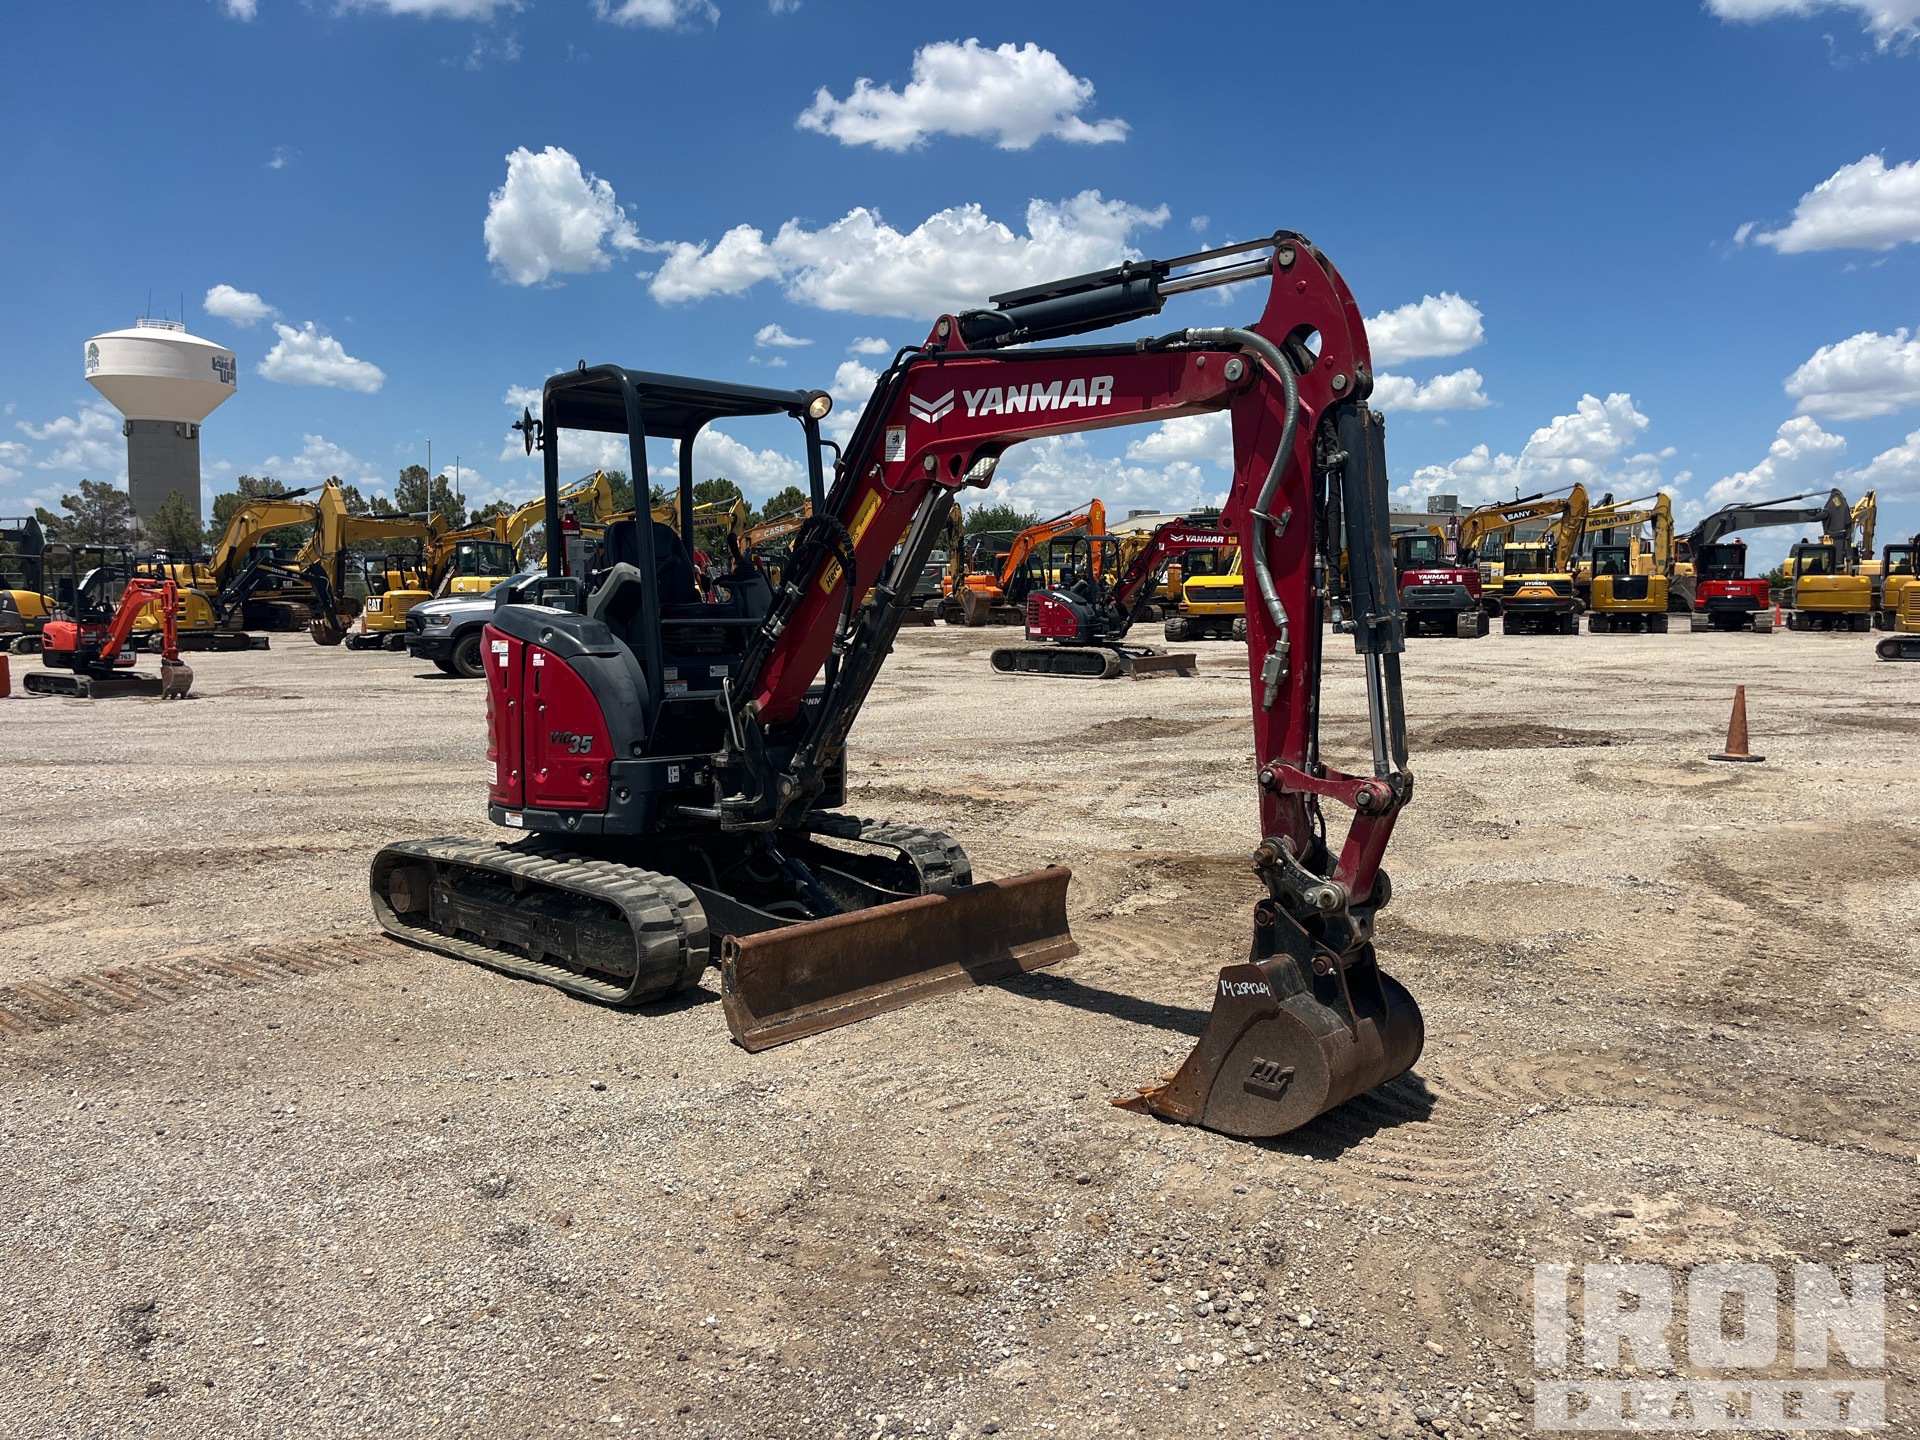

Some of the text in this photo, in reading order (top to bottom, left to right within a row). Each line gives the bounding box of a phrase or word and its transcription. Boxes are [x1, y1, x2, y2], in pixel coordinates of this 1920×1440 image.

[962, 375, 1114, 418] YANMAR
[1507, 510, 1531, 521] SANY
[1589, 514, 1630, 528] KOMATSU
[764, 525, 785, 537] CASE
[1185, 534, 1224, 543] YANMAR
[271, 567, 287, 576] DEERE
[367, 599, 381, 611] CAT
